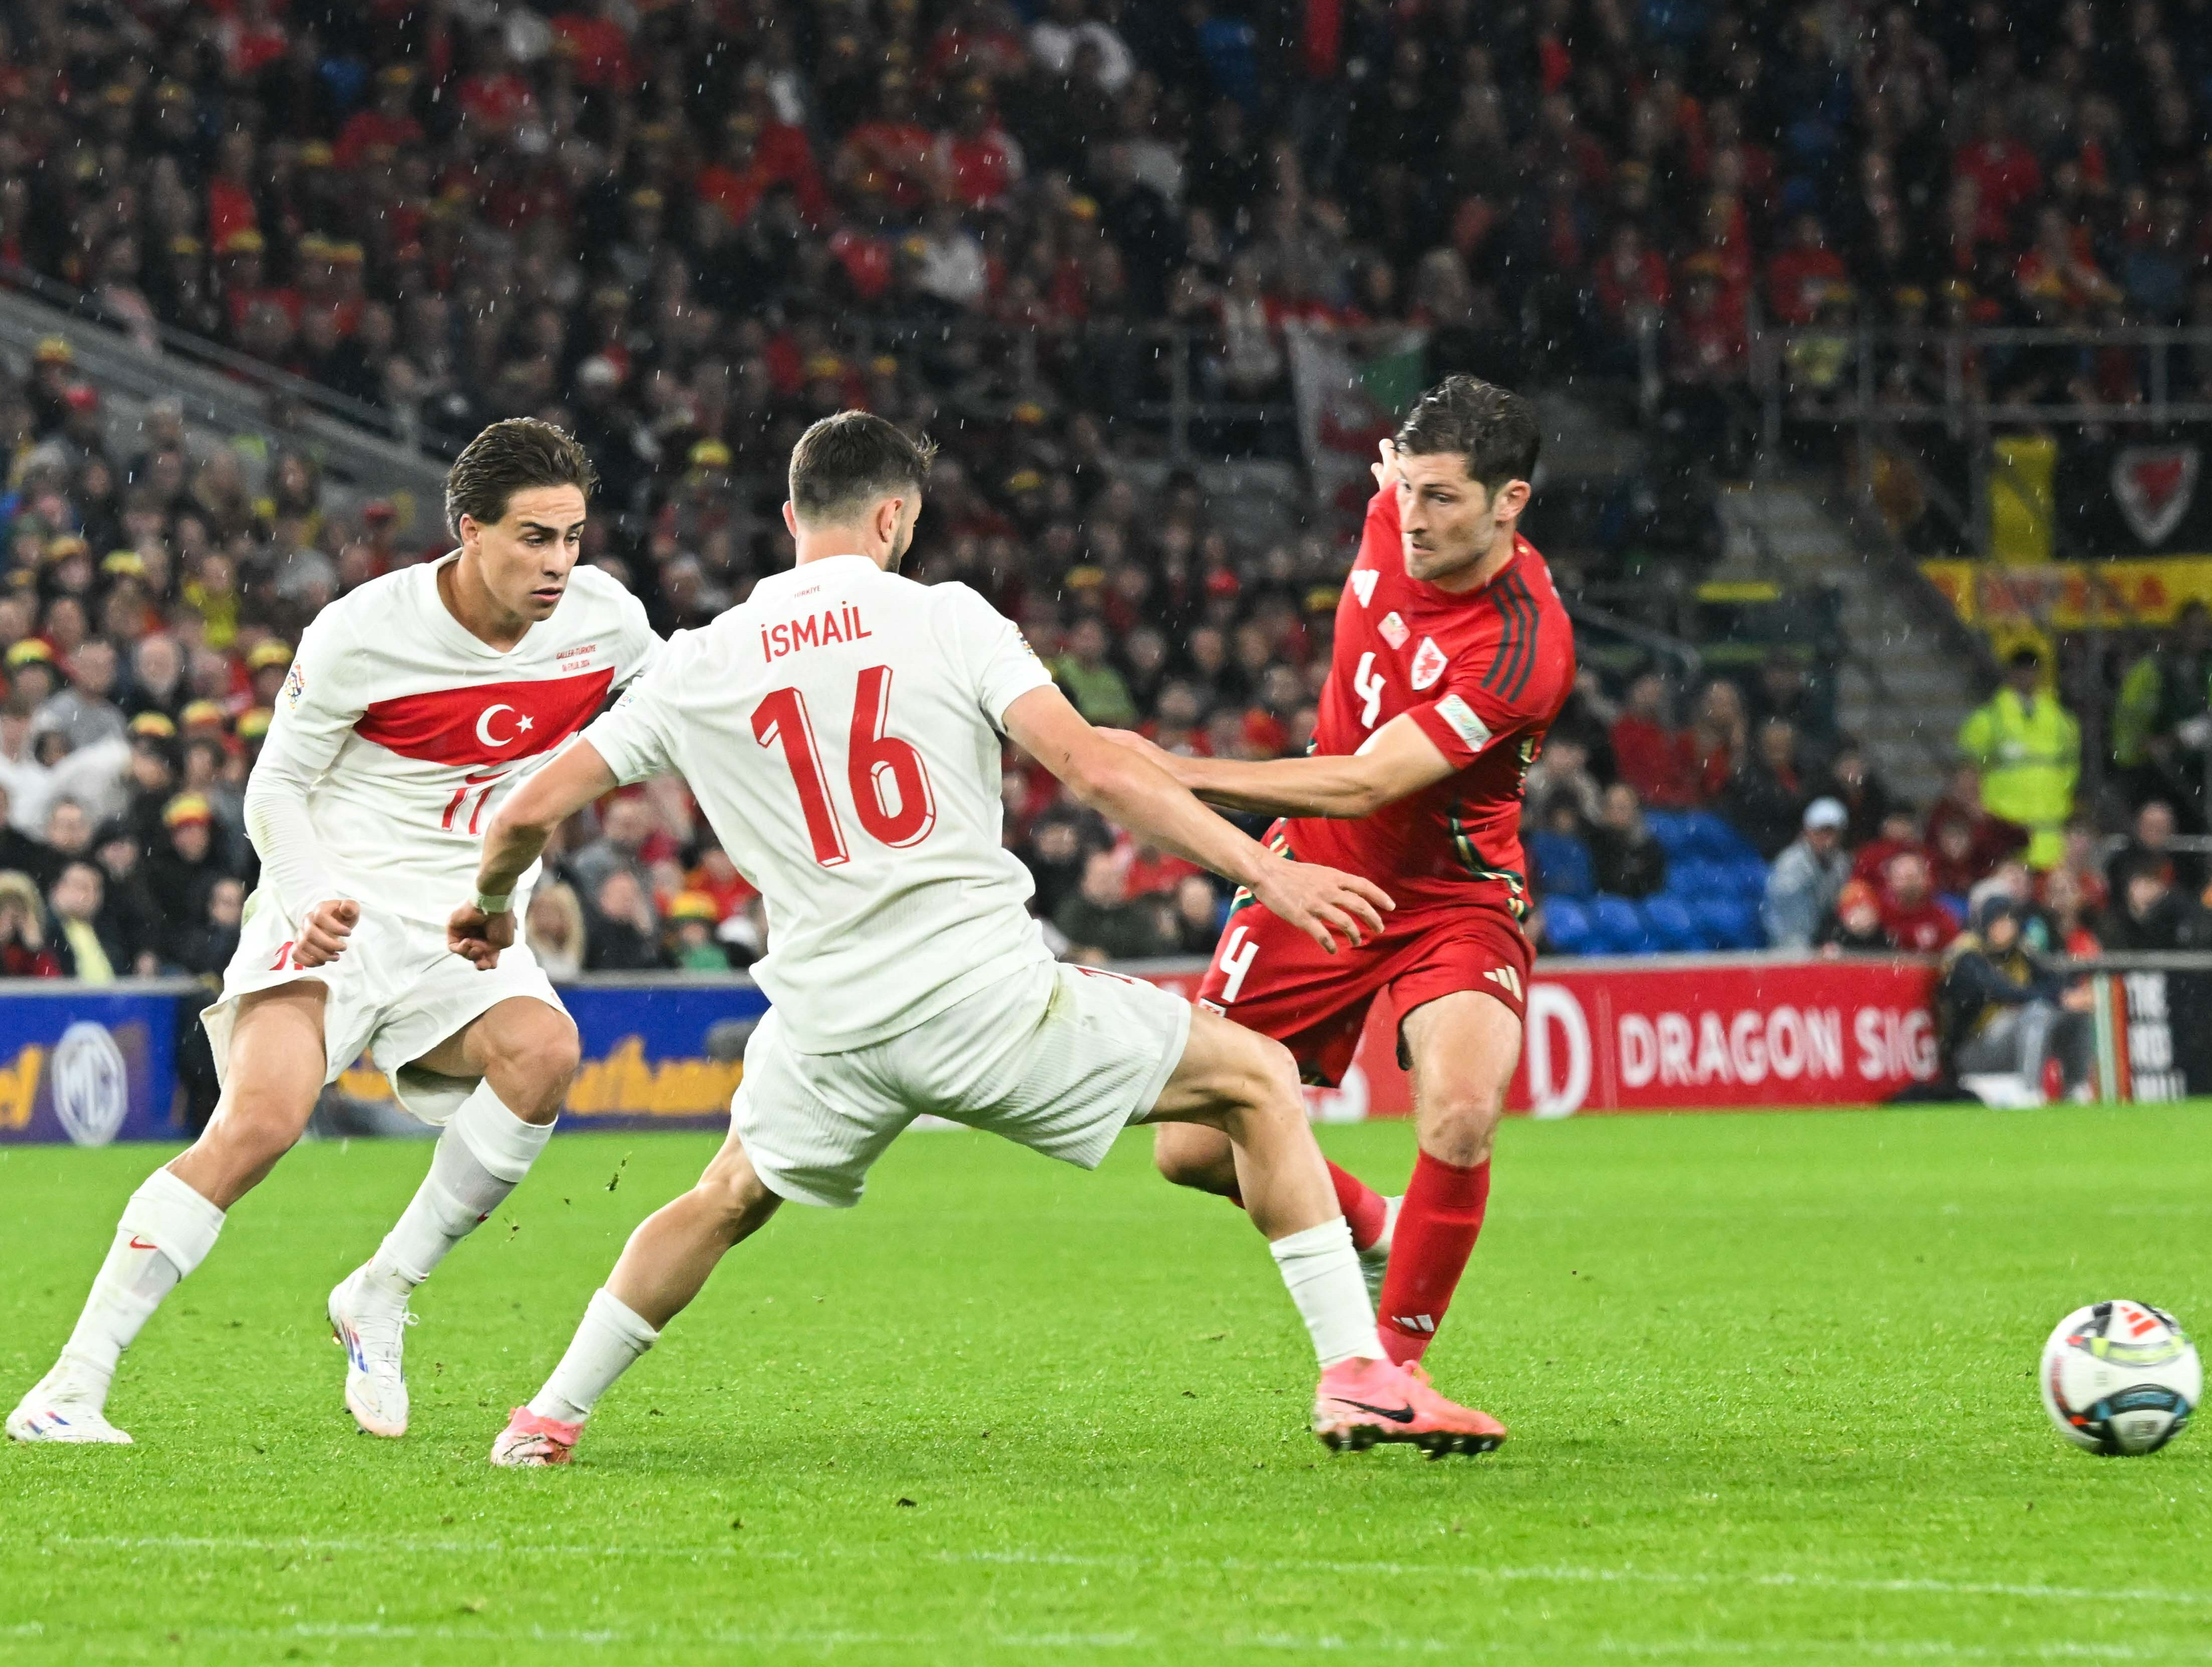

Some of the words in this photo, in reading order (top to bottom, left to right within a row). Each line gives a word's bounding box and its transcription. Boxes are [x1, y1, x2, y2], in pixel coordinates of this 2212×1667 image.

[761, 600, 872, 663] İSMAİL
[1354, 651, 1386, 729] 4
[751, 664, 936, 868] 16
[441, 783, 498, 837] 11
[1219, 925, 1259, 1003] 4
[1618, 1004, 1844, 1088] DRAGON
